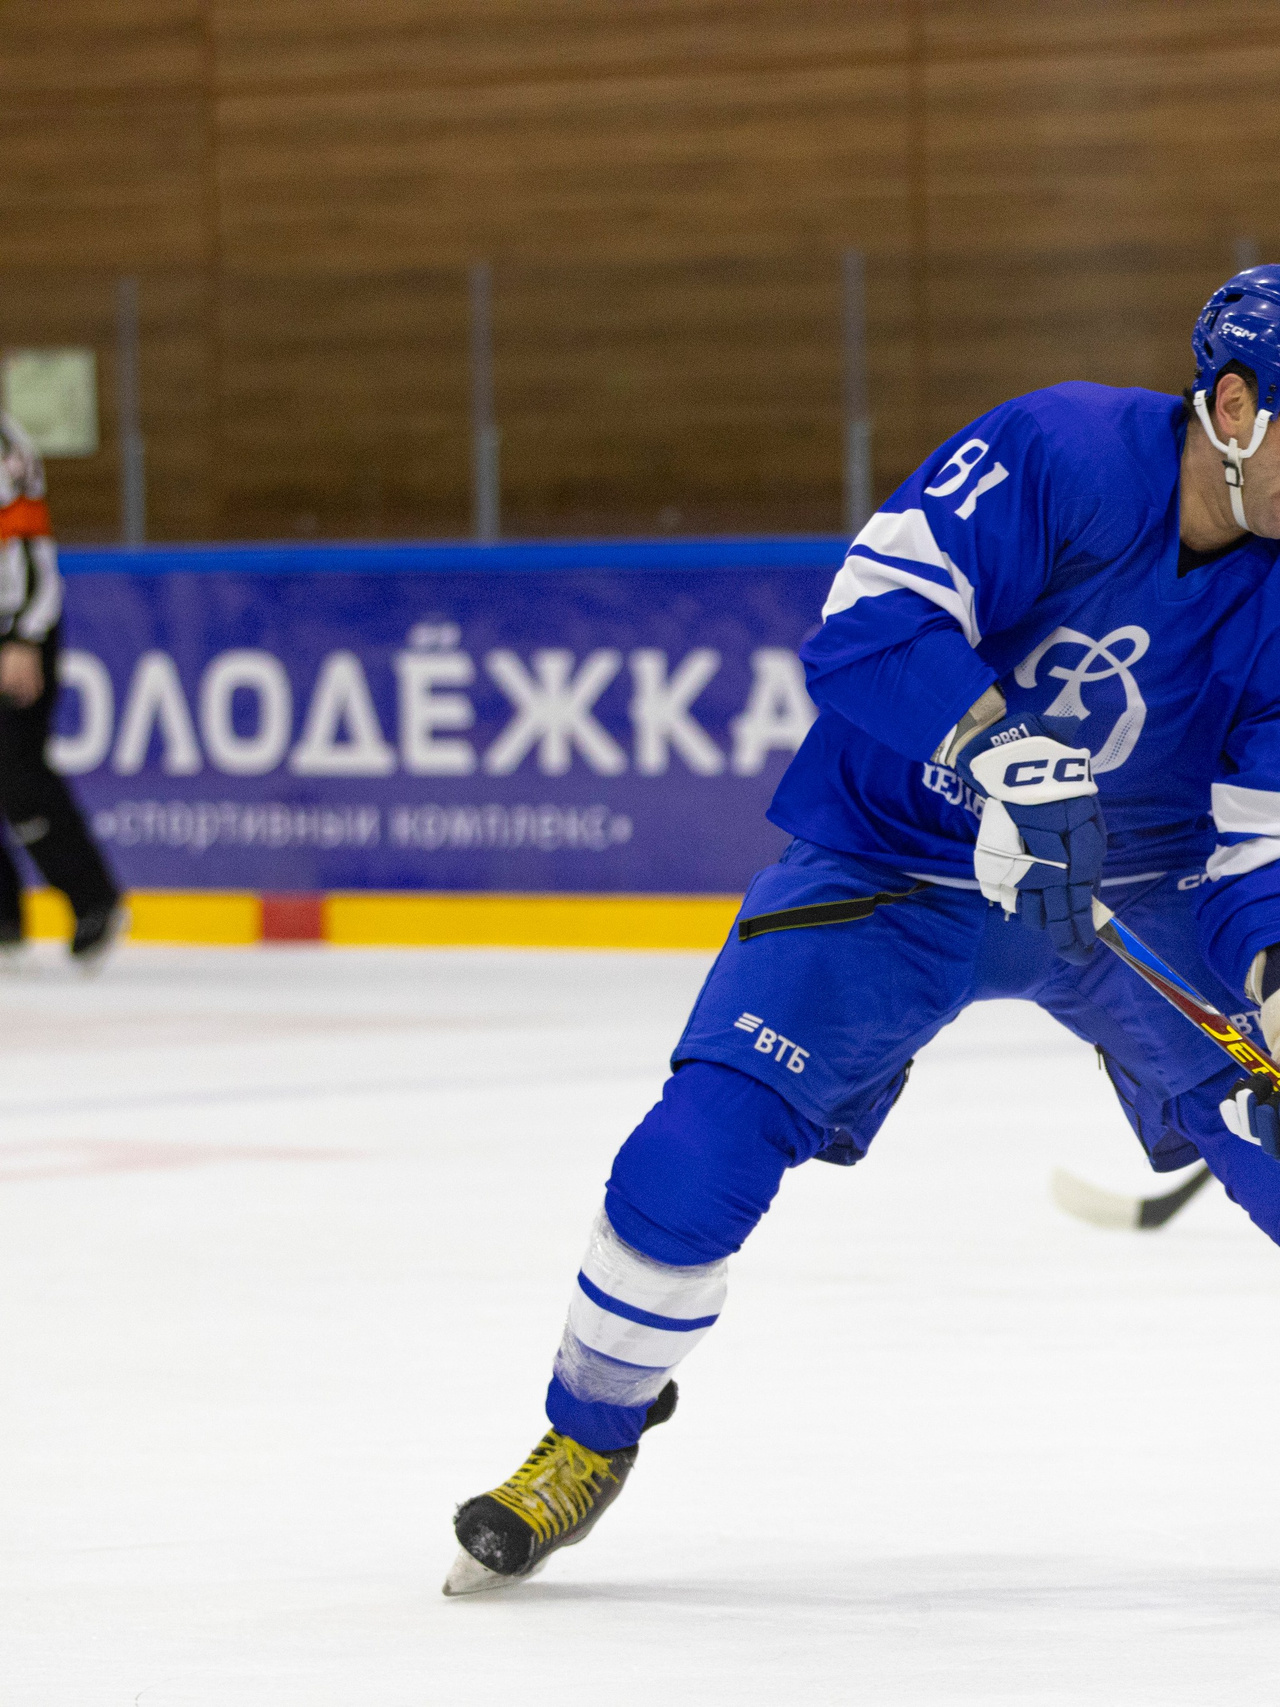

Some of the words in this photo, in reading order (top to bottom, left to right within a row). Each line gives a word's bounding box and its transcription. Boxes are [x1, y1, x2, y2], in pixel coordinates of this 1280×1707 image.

[1222, 322, 1257, 341] CCM
[924, 438, 1010, 521] 81
[1003, 757, 1093, 788] CC
[1229, 1010, 1261, 1035] ВТ
[754, 1027, 810, 1074] ВТБ
